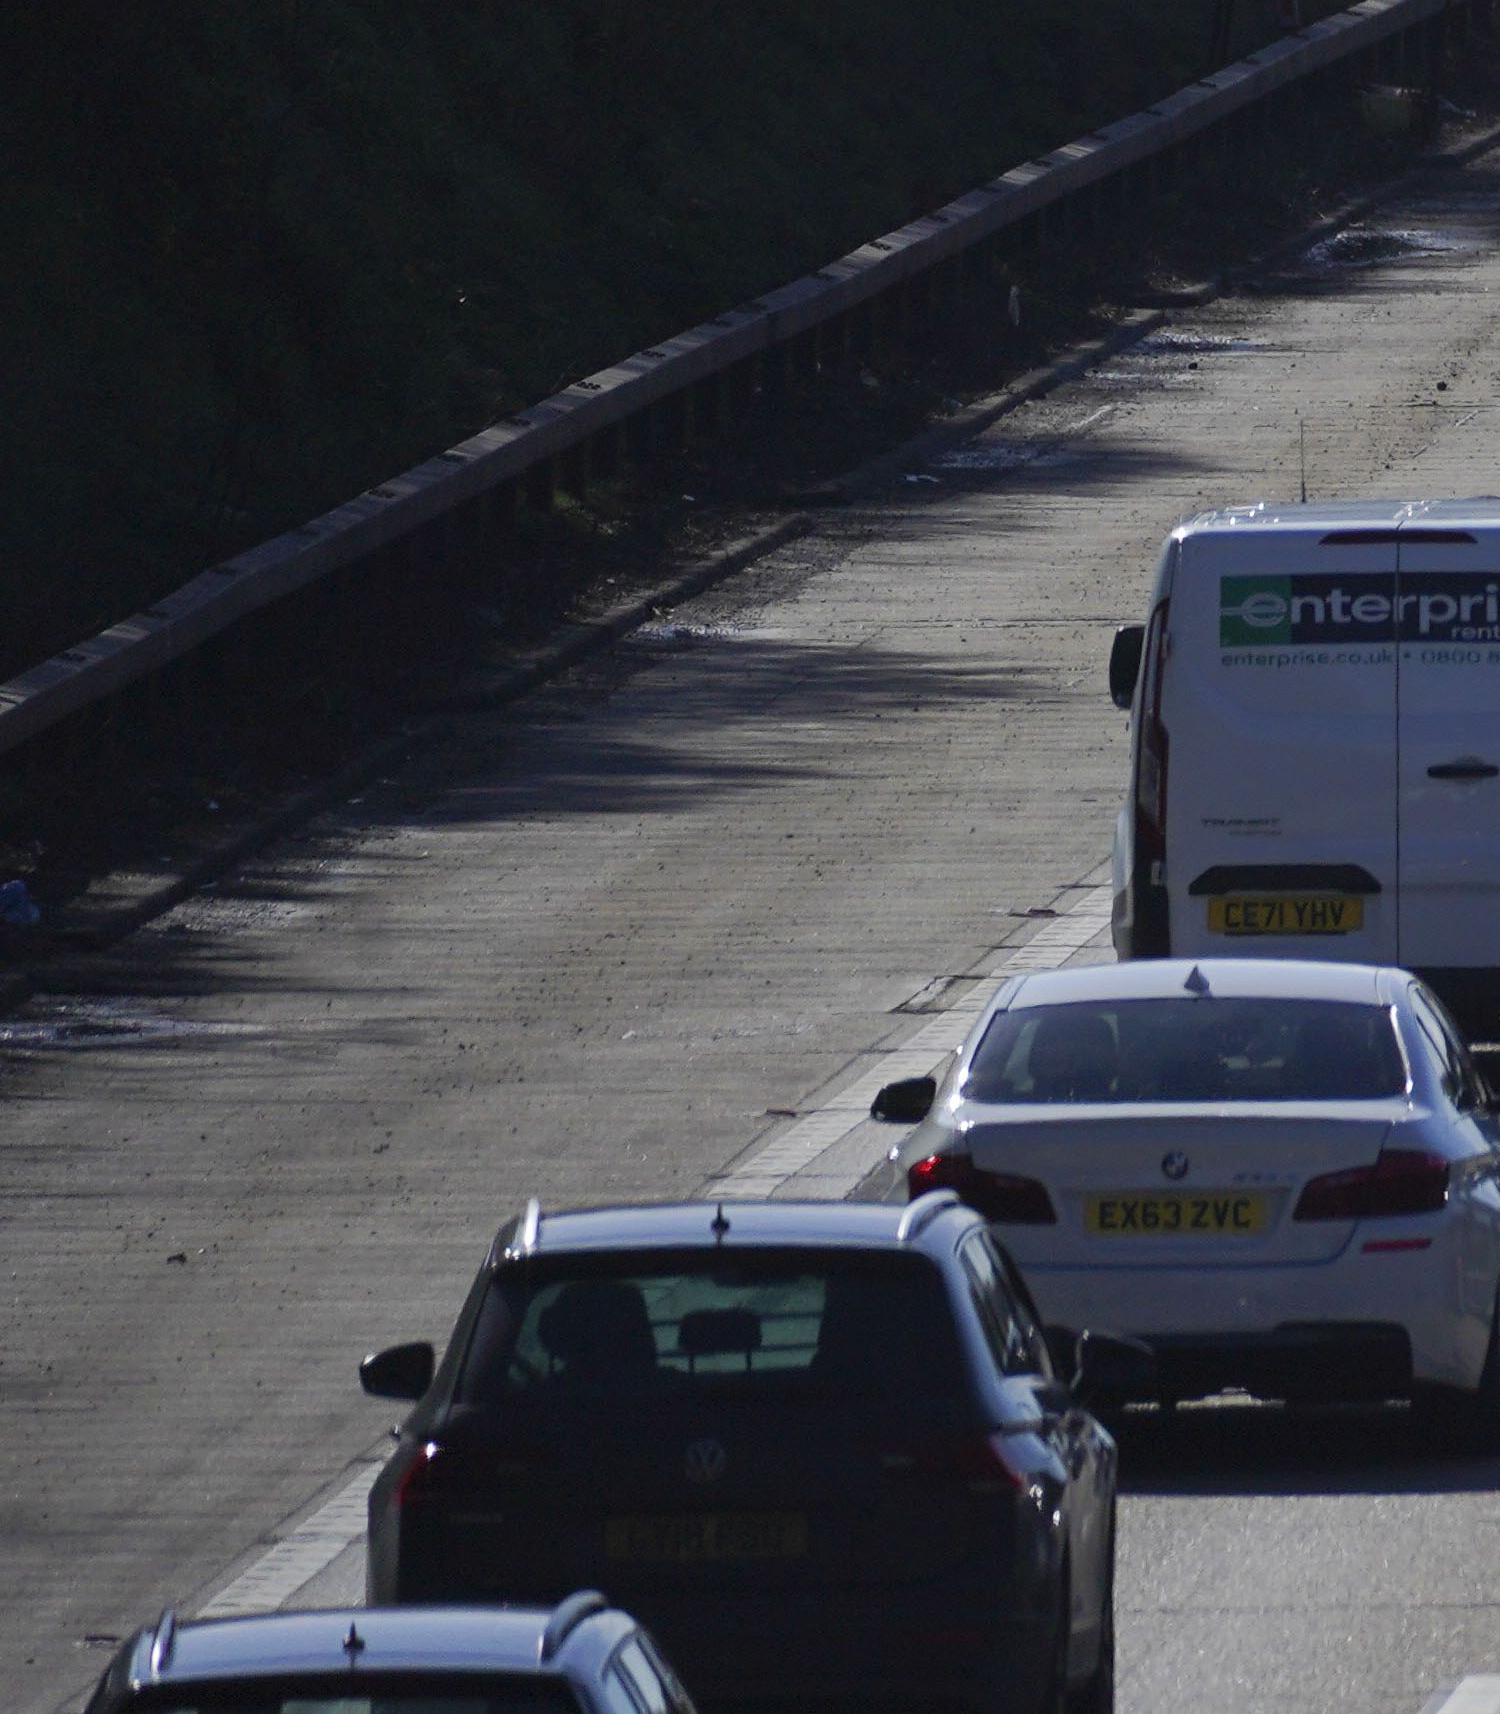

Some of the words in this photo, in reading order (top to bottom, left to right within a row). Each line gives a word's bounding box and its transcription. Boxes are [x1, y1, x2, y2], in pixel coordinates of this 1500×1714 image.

[1224, 902, 1284, 928] CE71
[1294, 901, 1345, 928] YHV
[1099, 1200, 1182, 1230] EX63
[1191, 1200, 1251, 1229] ZVC
